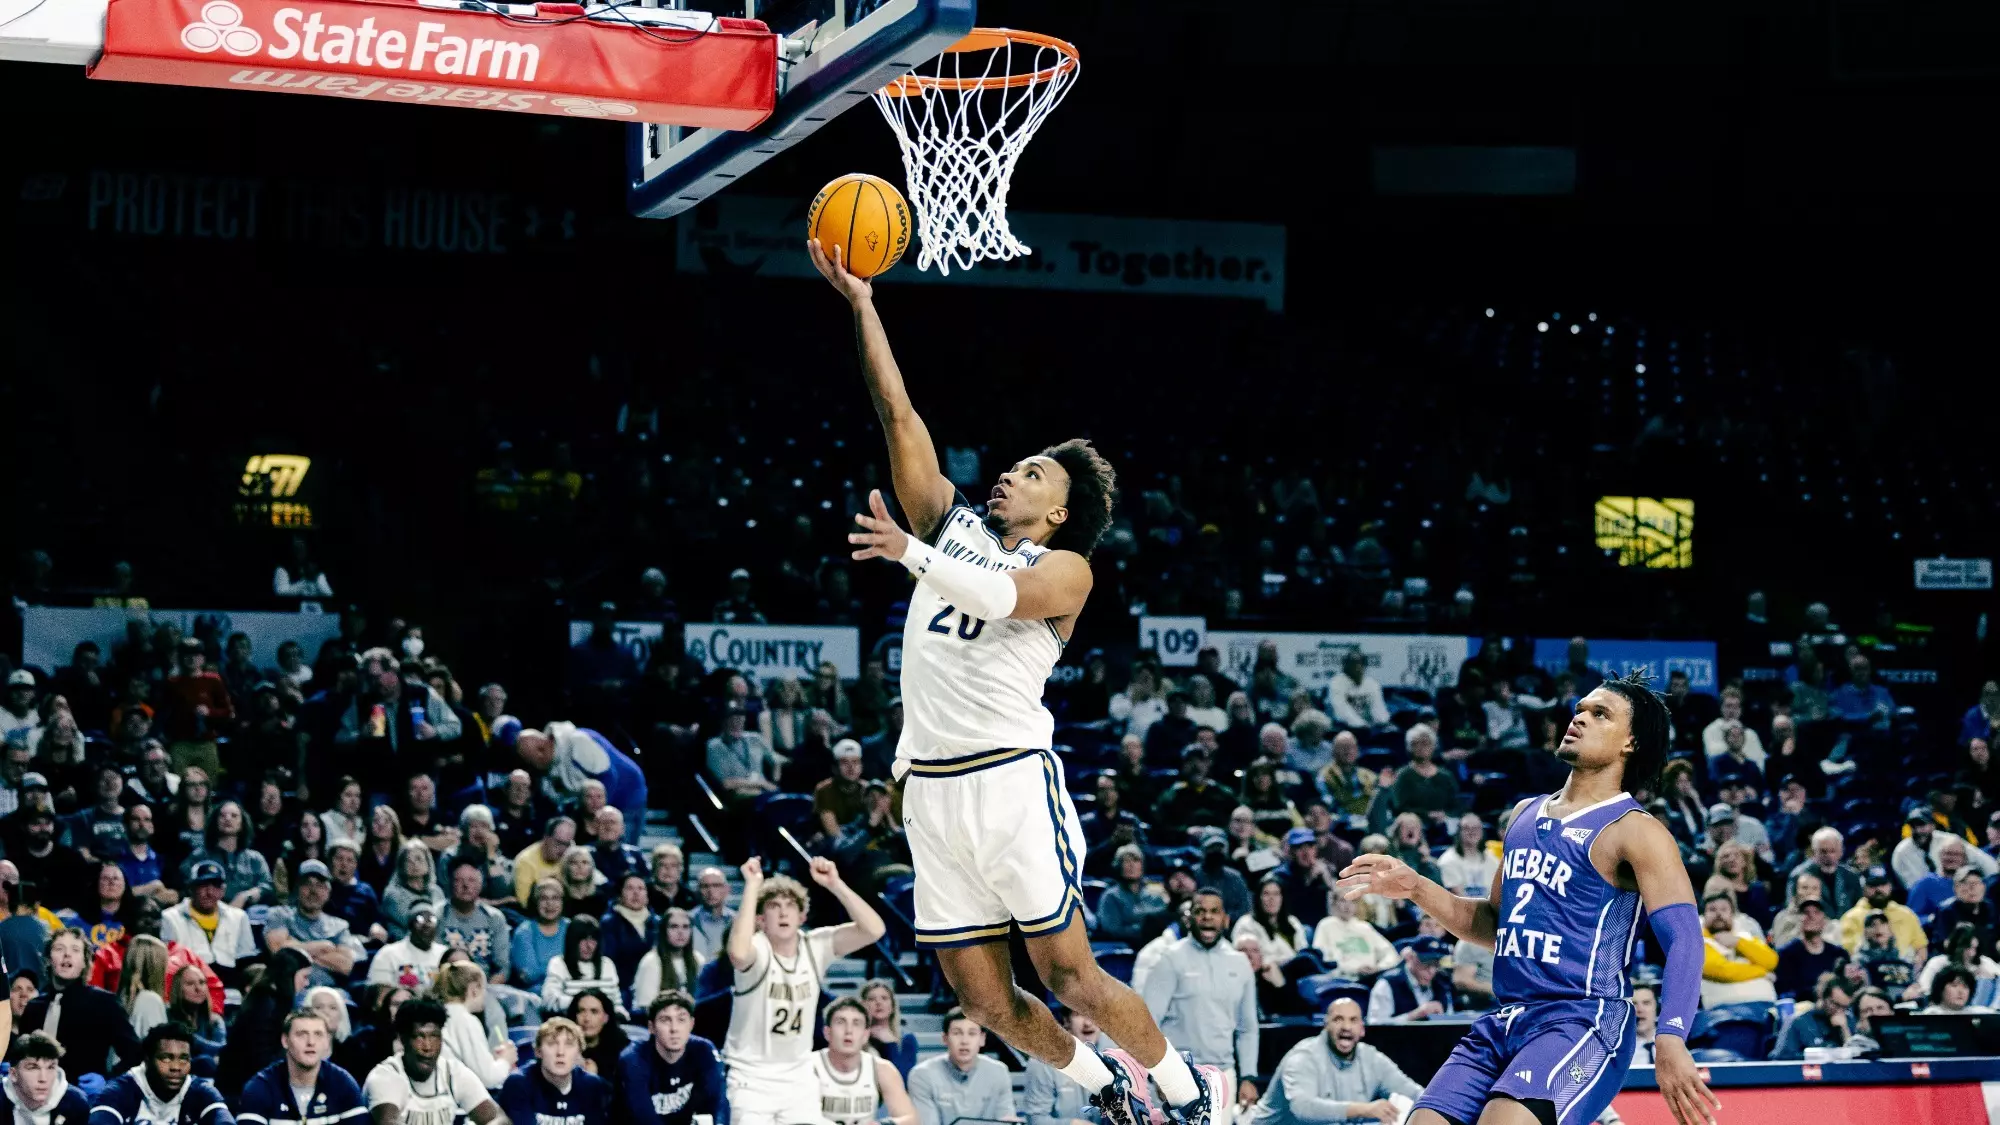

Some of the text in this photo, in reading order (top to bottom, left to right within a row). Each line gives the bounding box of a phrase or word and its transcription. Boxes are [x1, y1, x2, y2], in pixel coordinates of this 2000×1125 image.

[87, 171, 261, 240] PROTECT
[383, 188, 512, 254] HOUSE
[1069, 241, 1273, 285] Together.
[927, 604, 986, 640] 20
[1148, 629, 1199, 654] 109
[1507, 882, 1535, 925] 2
[1494, 926, 1563, 965] TATE
[771, 1007, 804, 1035] 24
